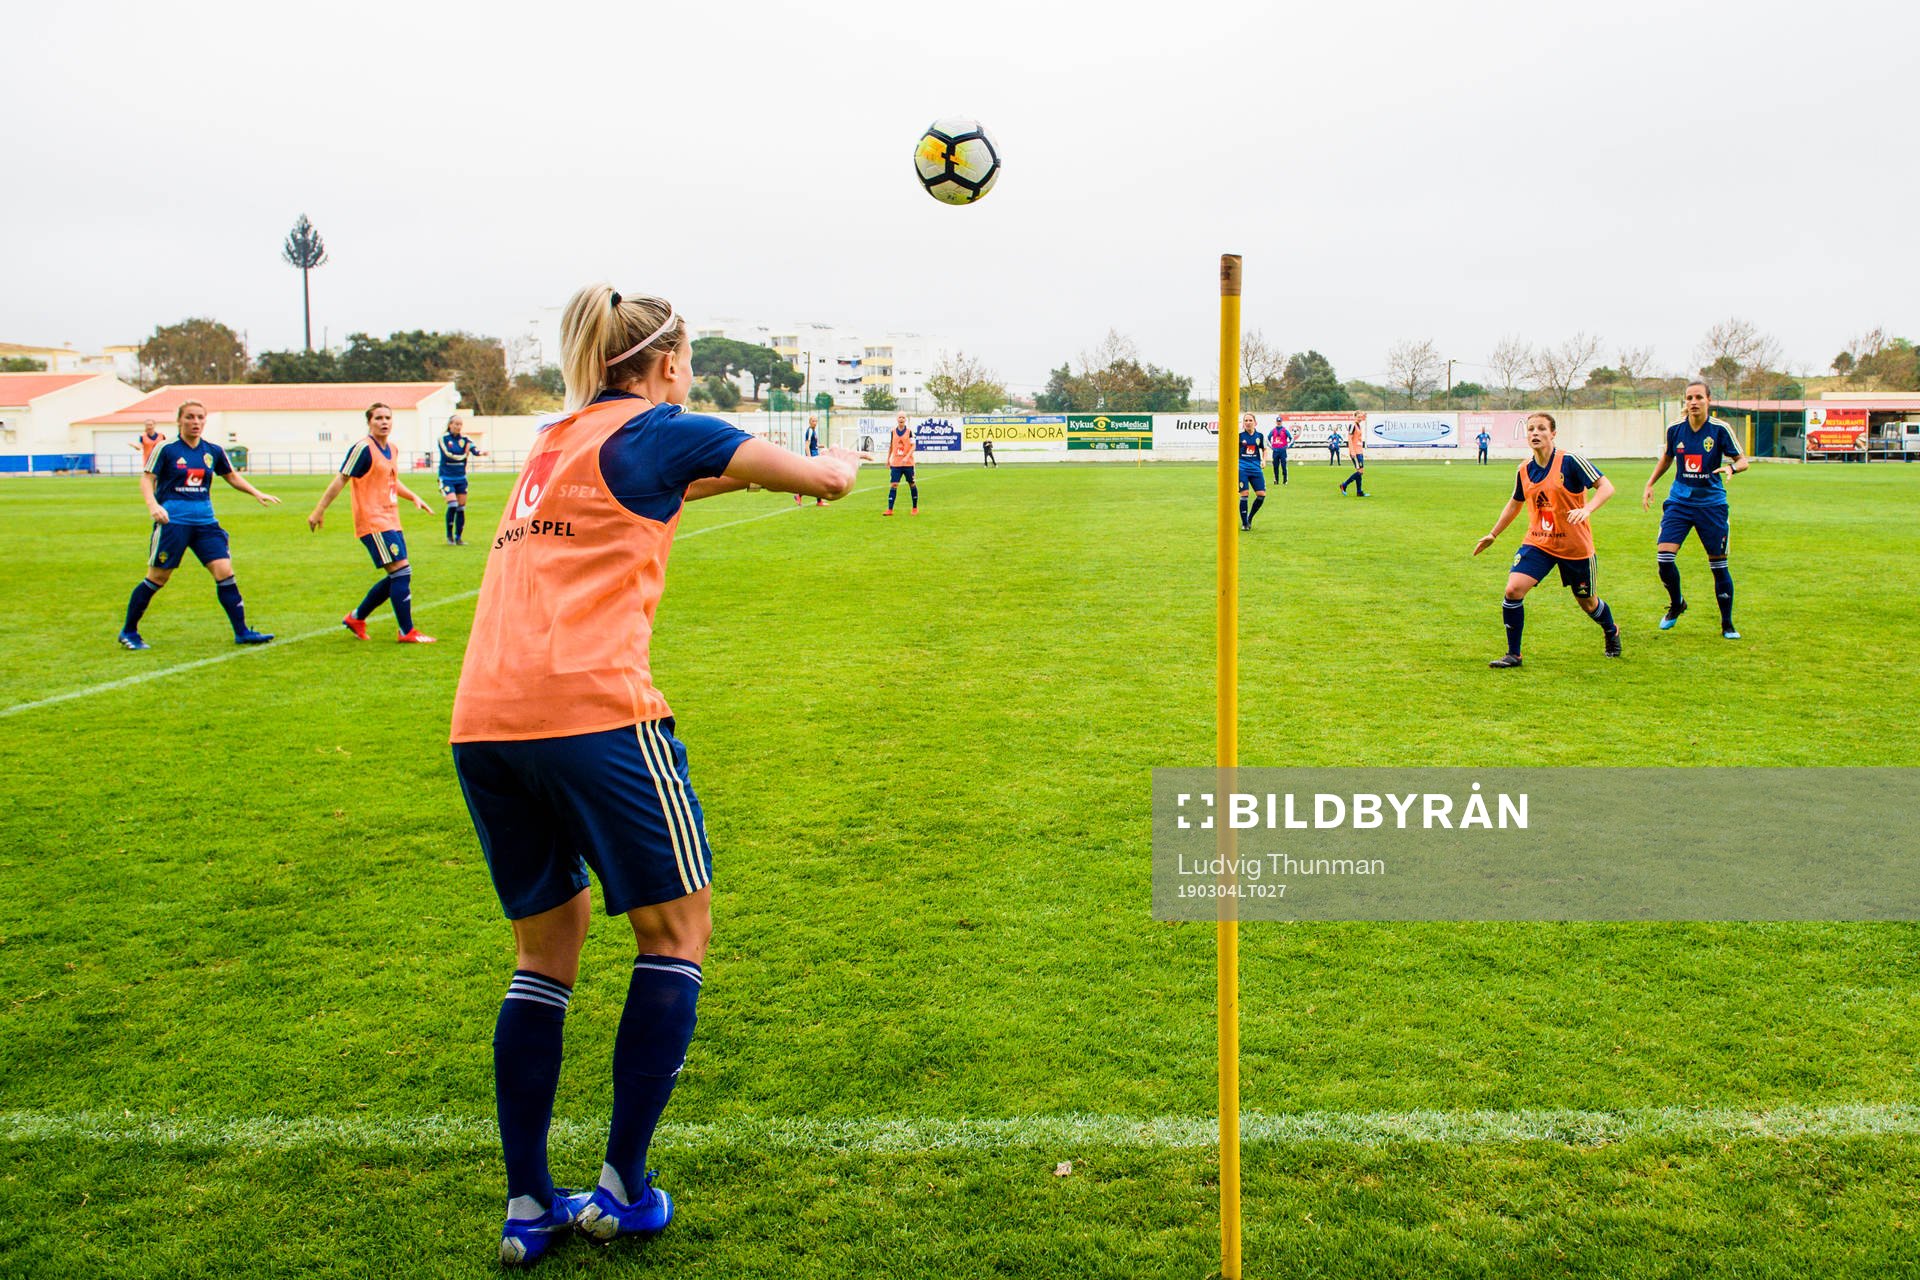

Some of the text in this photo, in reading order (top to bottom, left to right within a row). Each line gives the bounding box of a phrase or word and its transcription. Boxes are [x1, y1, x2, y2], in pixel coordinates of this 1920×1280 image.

[920, 425, 953, 436] Alb-Style
[1069, 420, 1094, 430] Kykus
[1110, 420, 1149, 429] EyeMedical
[1302, 423, 1350, 432] ALGARV
[1412, 420, 1441, 431] TRAVEL
[965, 424, 1018, 439] ESTÁDIO
[1027, 427, 1064, 439] NORA
[530, 519, 576, 537] SPEL
